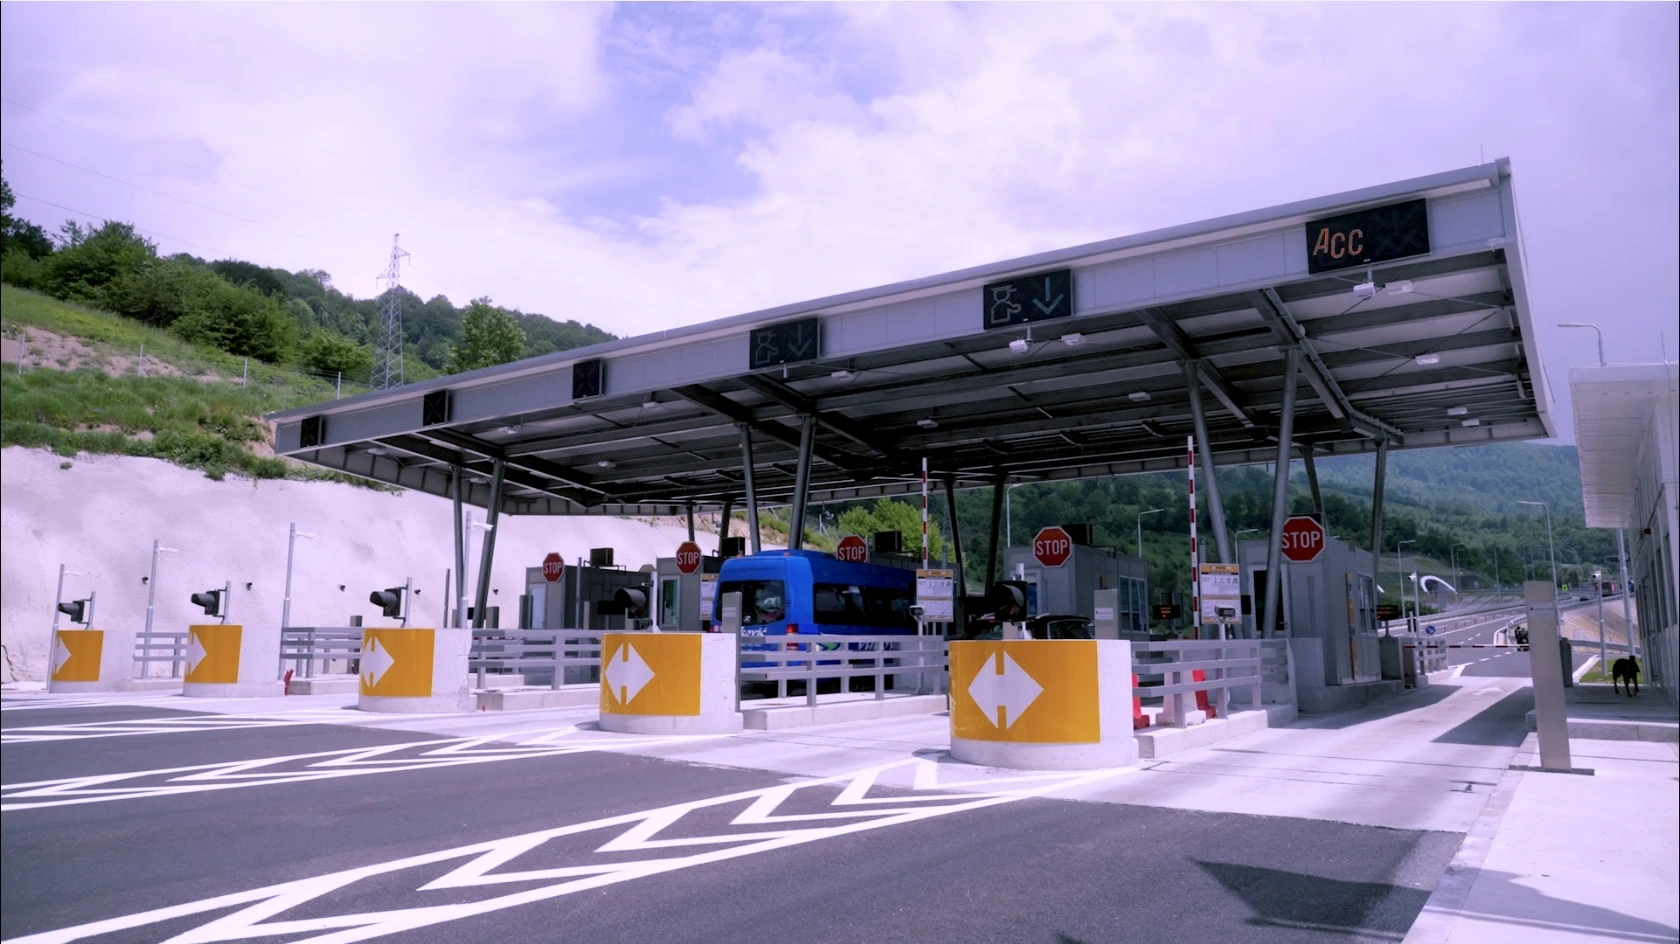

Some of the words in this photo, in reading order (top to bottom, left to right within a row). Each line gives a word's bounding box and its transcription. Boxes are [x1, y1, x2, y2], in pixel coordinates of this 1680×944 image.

[1282, 531, 1320, 550] STOP
[838, 546, 864, 561] STOP
[1036, 540, 1068, 556] STOP
[678, 552, 698, 565] STOP
[544, 562, 562, 574] STOP
[740, 626, 768, 637] ković
